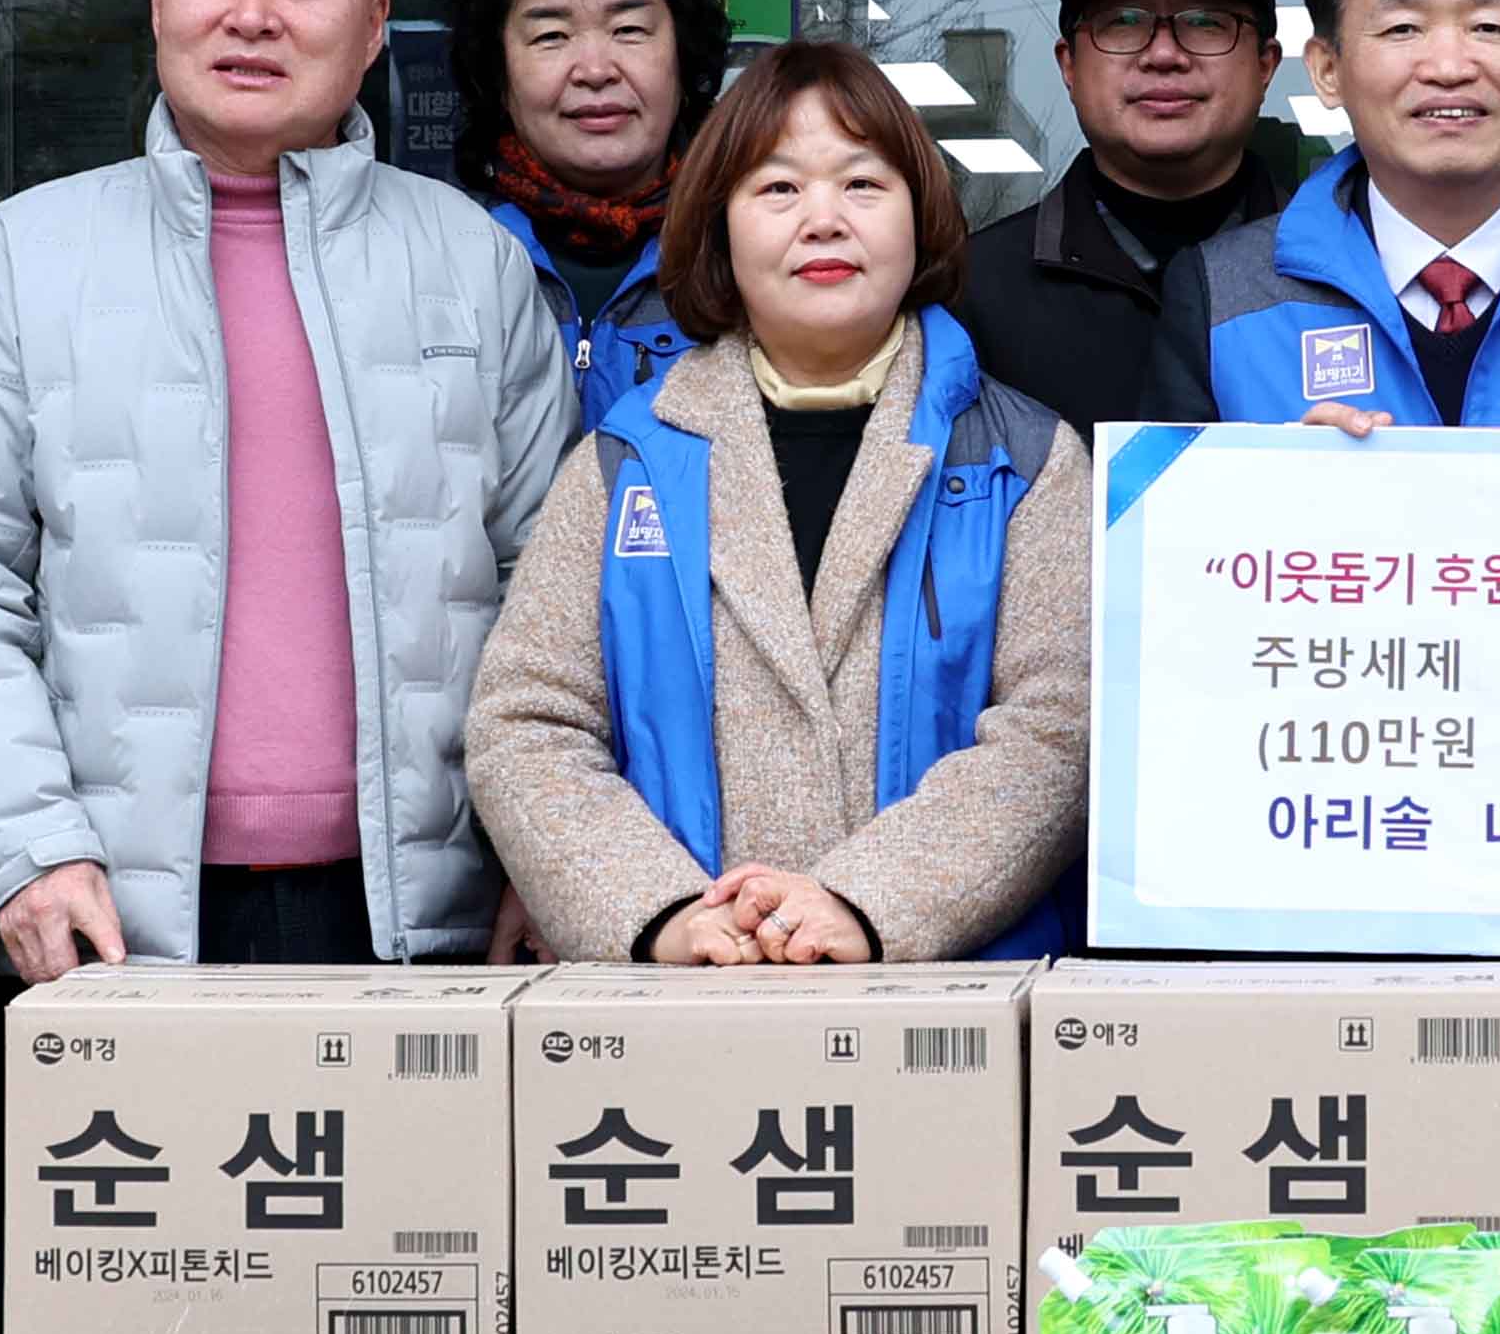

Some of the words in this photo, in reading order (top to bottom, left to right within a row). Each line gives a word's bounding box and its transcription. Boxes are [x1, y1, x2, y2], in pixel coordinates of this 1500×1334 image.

[1251, 637, 1462, 693] 주방세제
[1257, 717, 1477, 773] (110만원
[1267, 795, 1434, 853] 아리솔
[70, 1035, 117, 1064] 애경
[579, 1032, 626, 1062] 애경
[1092, 1020, 1139, 1049] 애경
[35, 1246, 274, 1285] 베이킹X피톤치드
[547, 1242, 786, 1284] 베이킹X피톤치드
[861, 1260, 955, 1291] 6102457
[350, 1266, 444, 1296] 6102457
